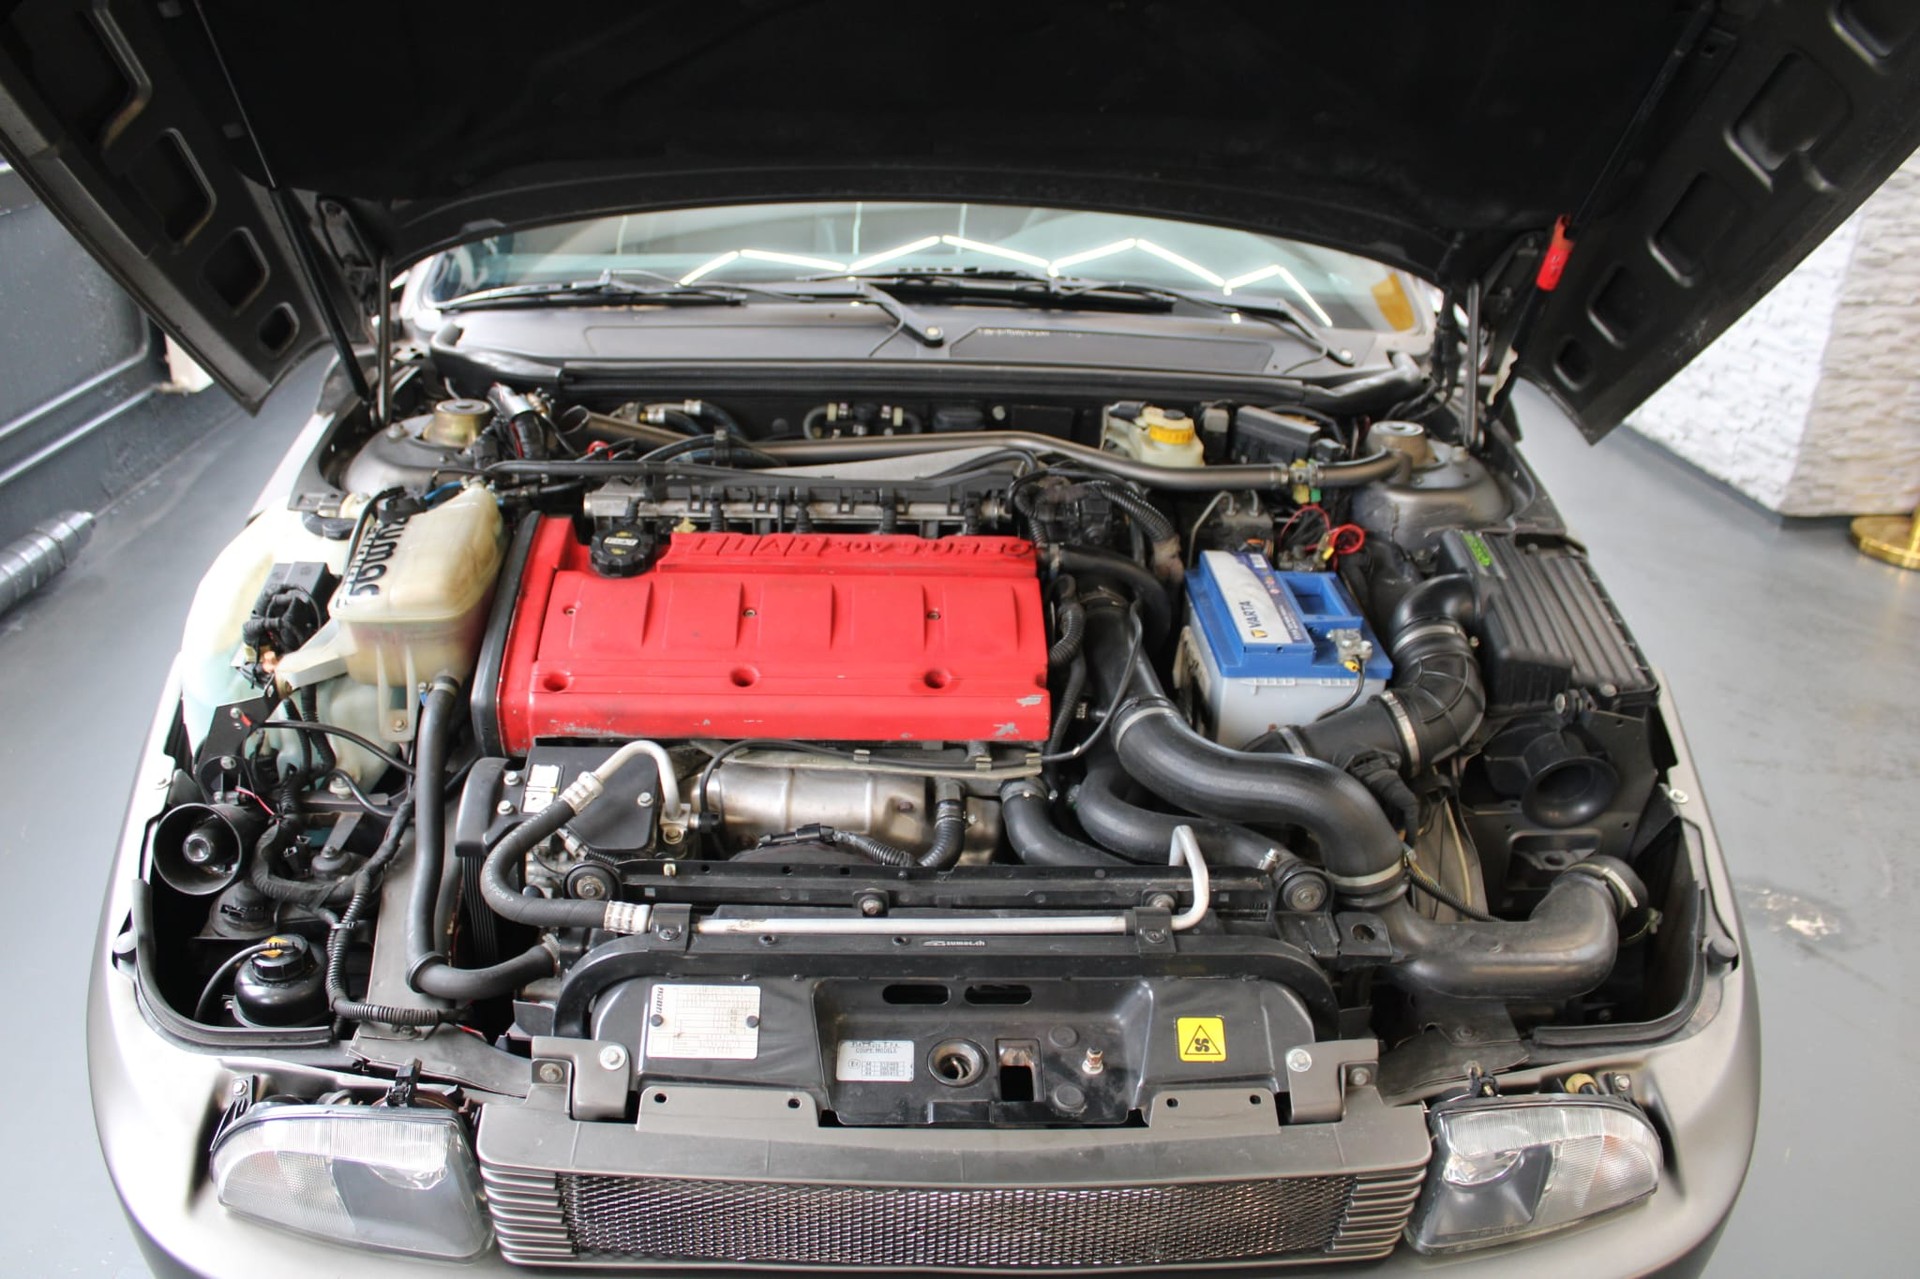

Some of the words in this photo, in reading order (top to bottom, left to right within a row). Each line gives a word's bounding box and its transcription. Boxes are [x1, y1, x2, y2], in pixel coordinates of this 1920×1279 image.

[692, 535, 829, 557] FIAT
[904, 541, 1033, 557] TURBO
[1238, 600, 1262, 628] VARTA
